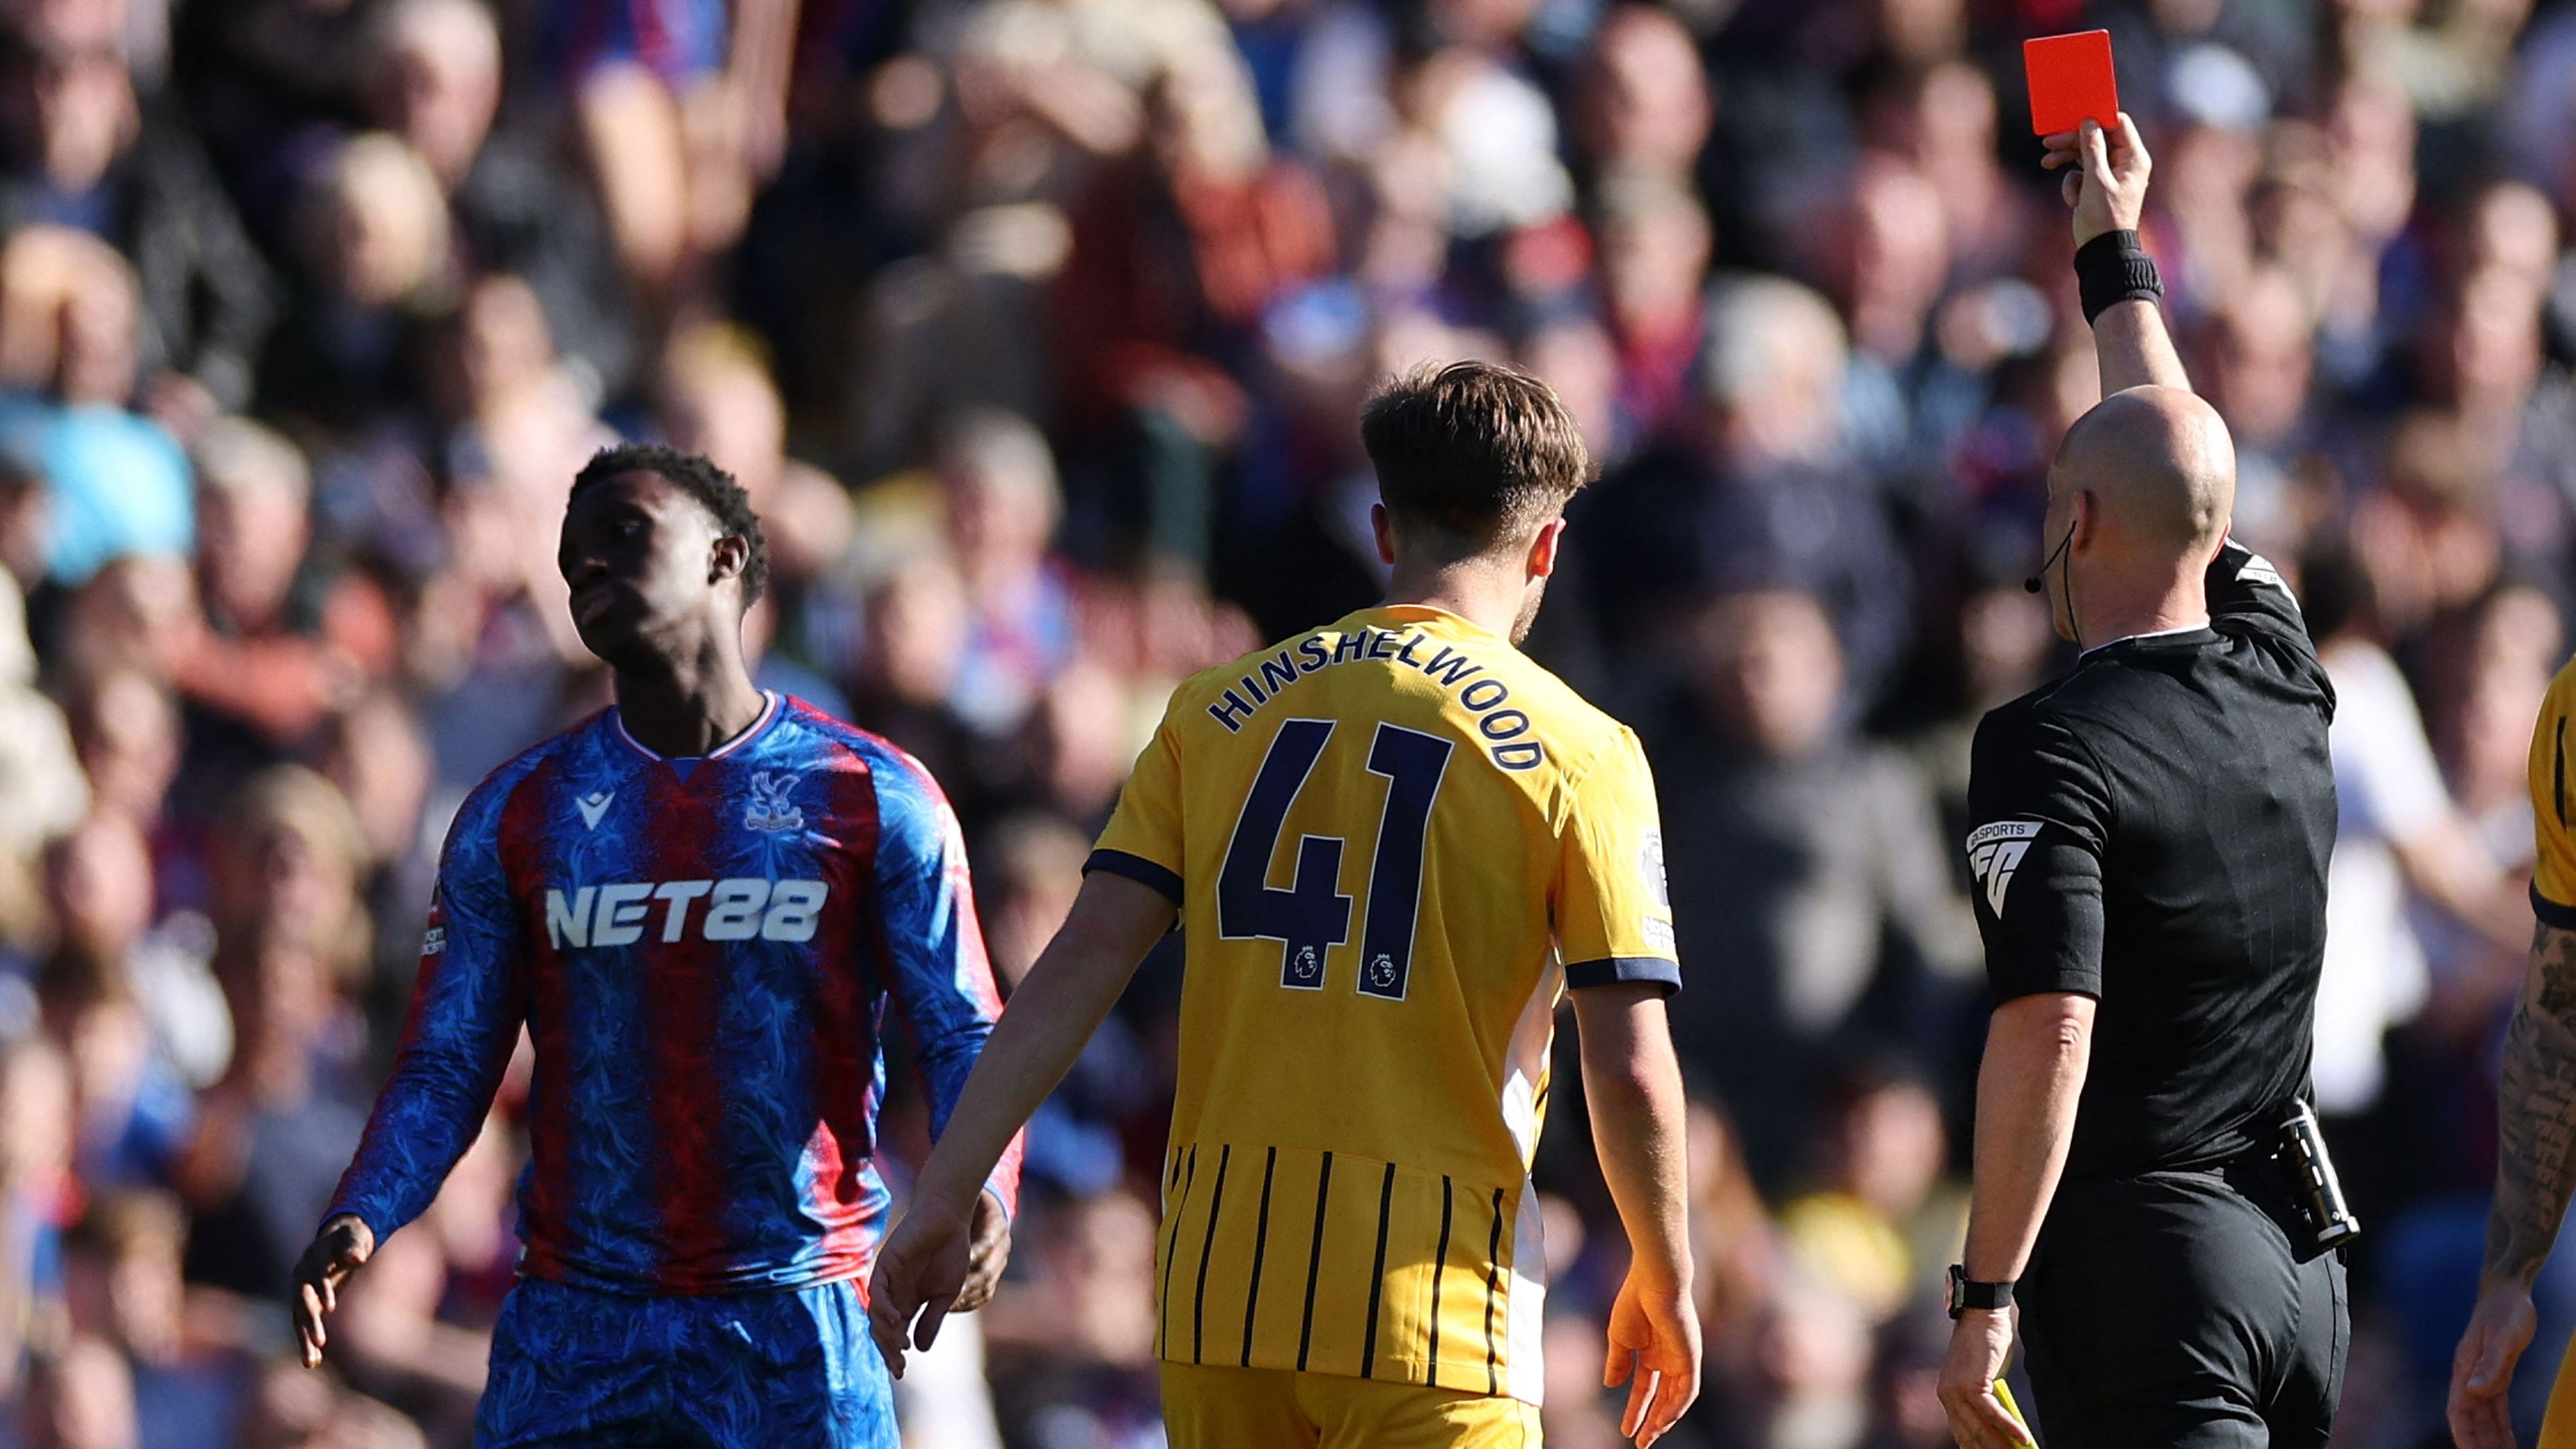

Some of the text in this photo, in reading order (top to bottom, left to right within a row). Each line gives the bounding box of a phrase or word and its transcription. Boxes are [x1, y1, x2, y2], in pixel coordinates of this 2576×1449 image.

[1207, 630, 1543, 770] HINSHELWOOD
[1216, 718, 1455, 1001] 41
[1979, 824, 2025, 840] SPORTS
[545, 879, 829, 950] NET88
